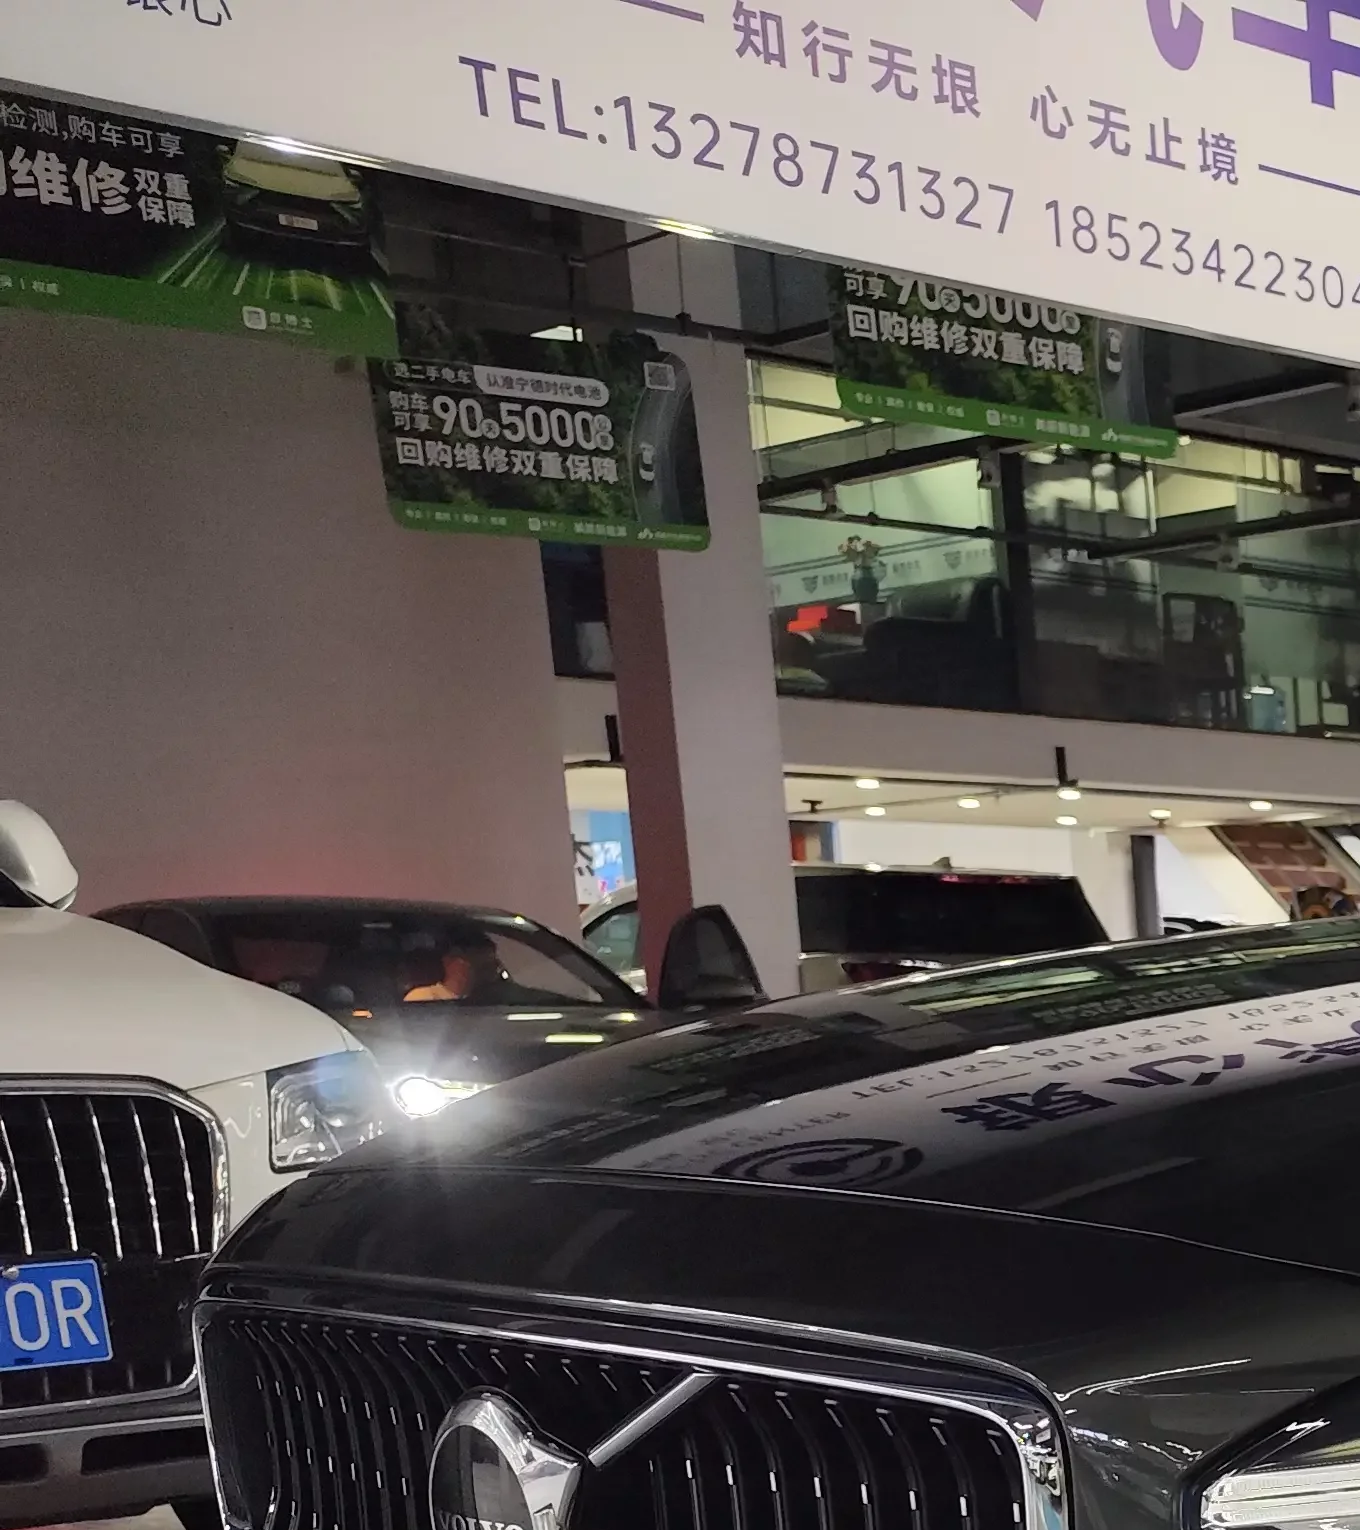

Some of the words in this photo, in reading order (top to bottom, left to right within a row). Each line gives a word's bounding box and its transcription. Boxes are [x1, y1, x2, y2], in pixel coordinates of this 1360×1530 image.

[732, 1, 981, 119] 知行无垠
[1029, 84, 1239, 186] 心无止境
[0, 145, 133, 216] 维修
[458, 55, 1015, 235] TEL:13278731327
[845, 303, 1085, 376] 回购维修双重保障
[394, 435, 620, 485] 回购维修双重保障
